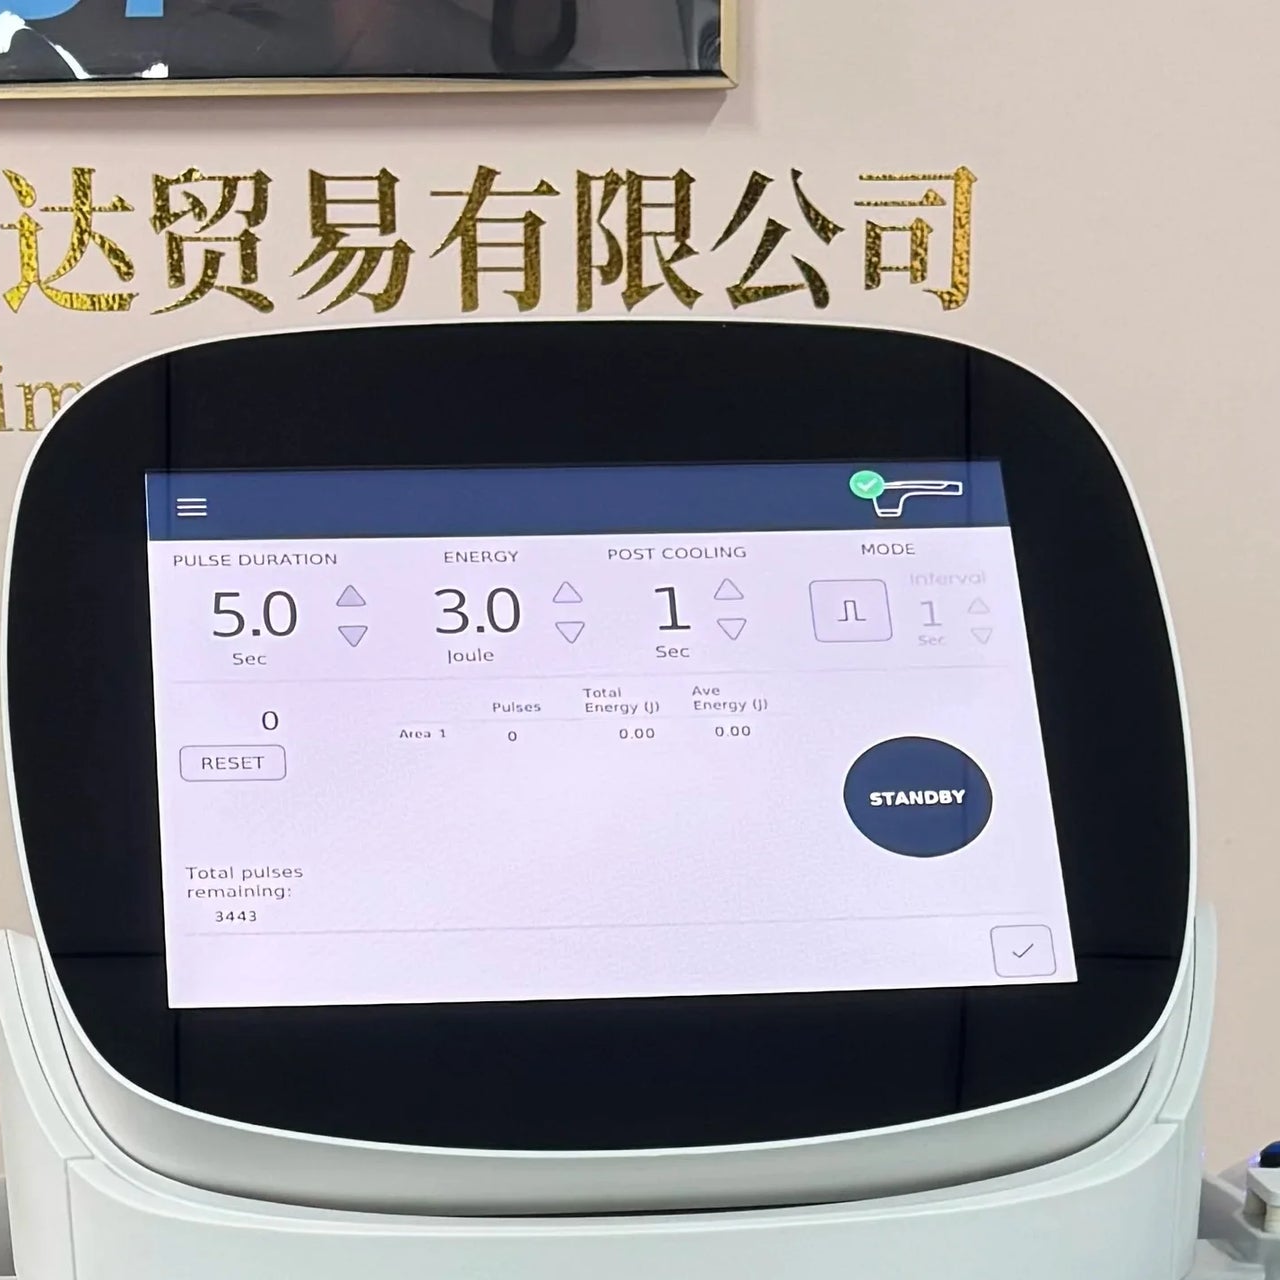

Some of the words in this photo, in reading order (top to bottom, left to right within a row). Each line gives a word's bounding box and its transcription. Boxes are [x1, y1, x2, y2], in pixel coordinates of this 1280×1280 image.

[607, 547, 655, 561] POST
[661, 546, 747, 560] COOLING
[861, 543, 916, 556] MODE
[173, 554, 231, 567] PULSE
[238, 553, 337, 566] DURATION
[444, 550, 519, 564] ENERGY
[909, 571, 986, 587] Interval
[212, 590, 298, 638] 5.0
[434, 587, 521, 635] 3.0
[654, 586, 691, 631] 1
[920, 600, 943, 627] 1
[917, 634, 945, 647] Sec
[232, 652, 267, 666] Sec
[447, 647, 495, 665] Joule
[655, 645, 690, 659] Sec
[582, 687, 622, 699] Total
[691, 685, 720, 697] Ave
[492, 701, 542, 713] Pulses
[584, 702, 638, 715] Energy
[644, 701, 660, 715] (J)
[693, 700, 747, 713] Energy
[752, 698, 768, 712] (J)
[261, 710, 279, 731] 0
[399, 729, 432, 739] Area
[440, 728, 446, 738] 1
[507, 730, 518, 742] 0
[619, 727, 655, 740] 0.00
[714, 725, 751, 737] 0.00
[201, 756, 265, 770] RESET
[869, 789, 966, 806] STANDBY
[185, 866, 234, 880] Total
[242, 866, 304, 882] pulses
[187, 884, 291, 901] remaining:
[215, 910, 257, 923] 3443
